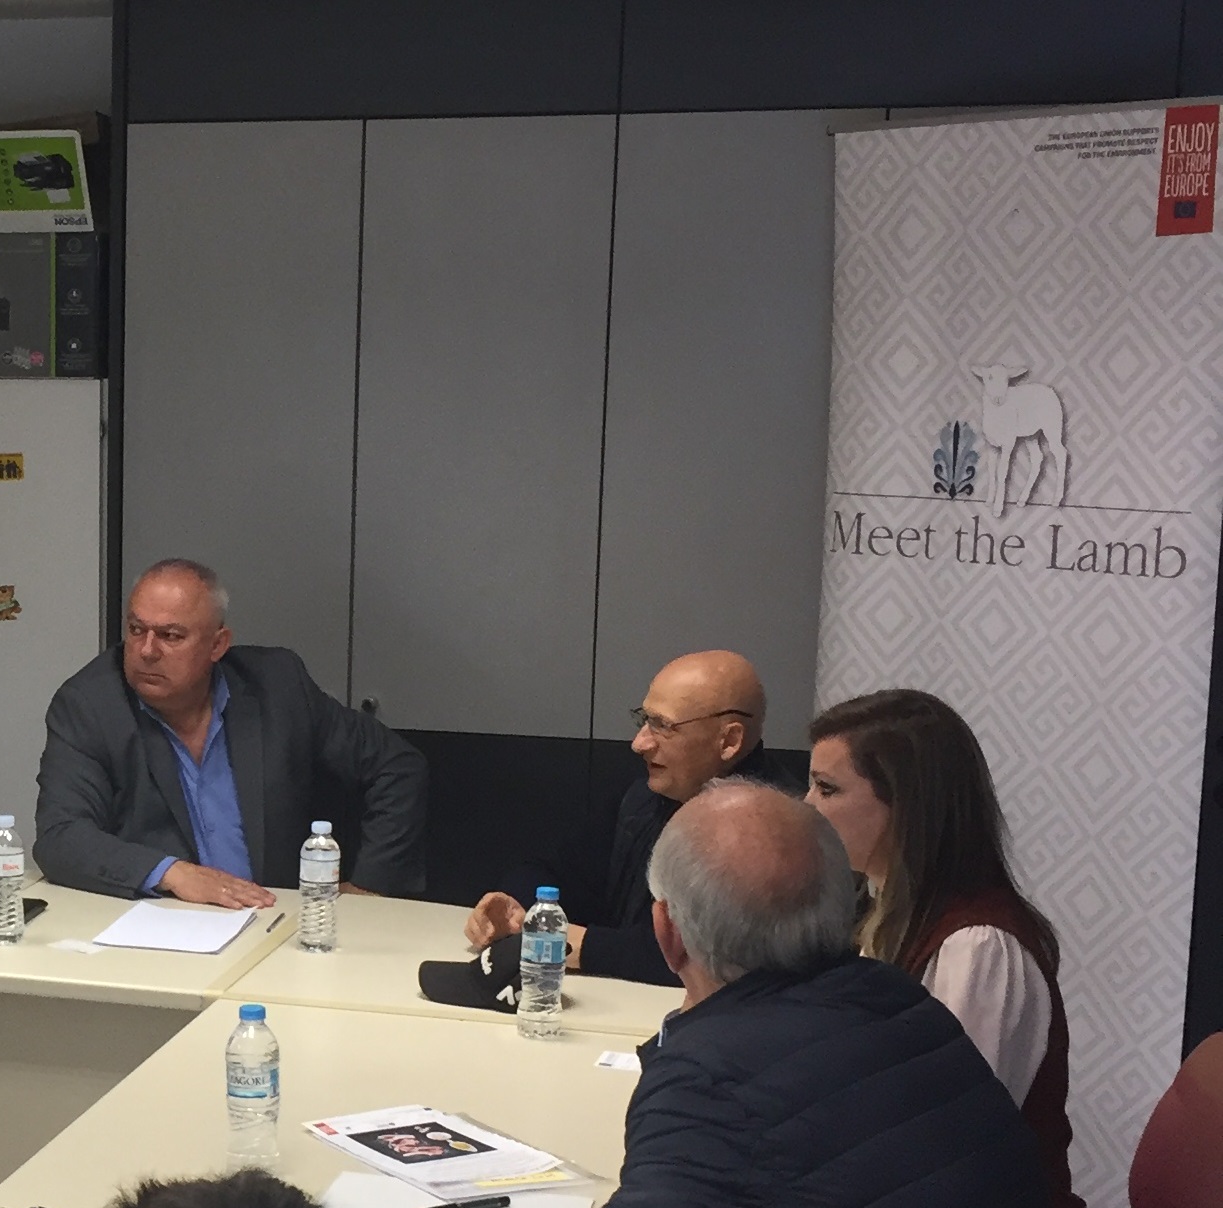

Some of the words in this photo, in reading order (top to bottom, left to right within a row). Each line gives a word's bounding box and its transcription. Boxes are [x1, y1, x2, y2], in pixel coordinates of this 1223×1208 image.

[1167, 122, 1215, 153] ENJOY
[1167, 155, 1184, 173] IT'S
[1185, 153, 1211, 173] FROM
[1164, 173, 1209, 197] EUROPE
[829, 510, 937, 560] Meet
[955, 516, 1026, 567] the
[1046, 524, 1187, 579] Lamb
